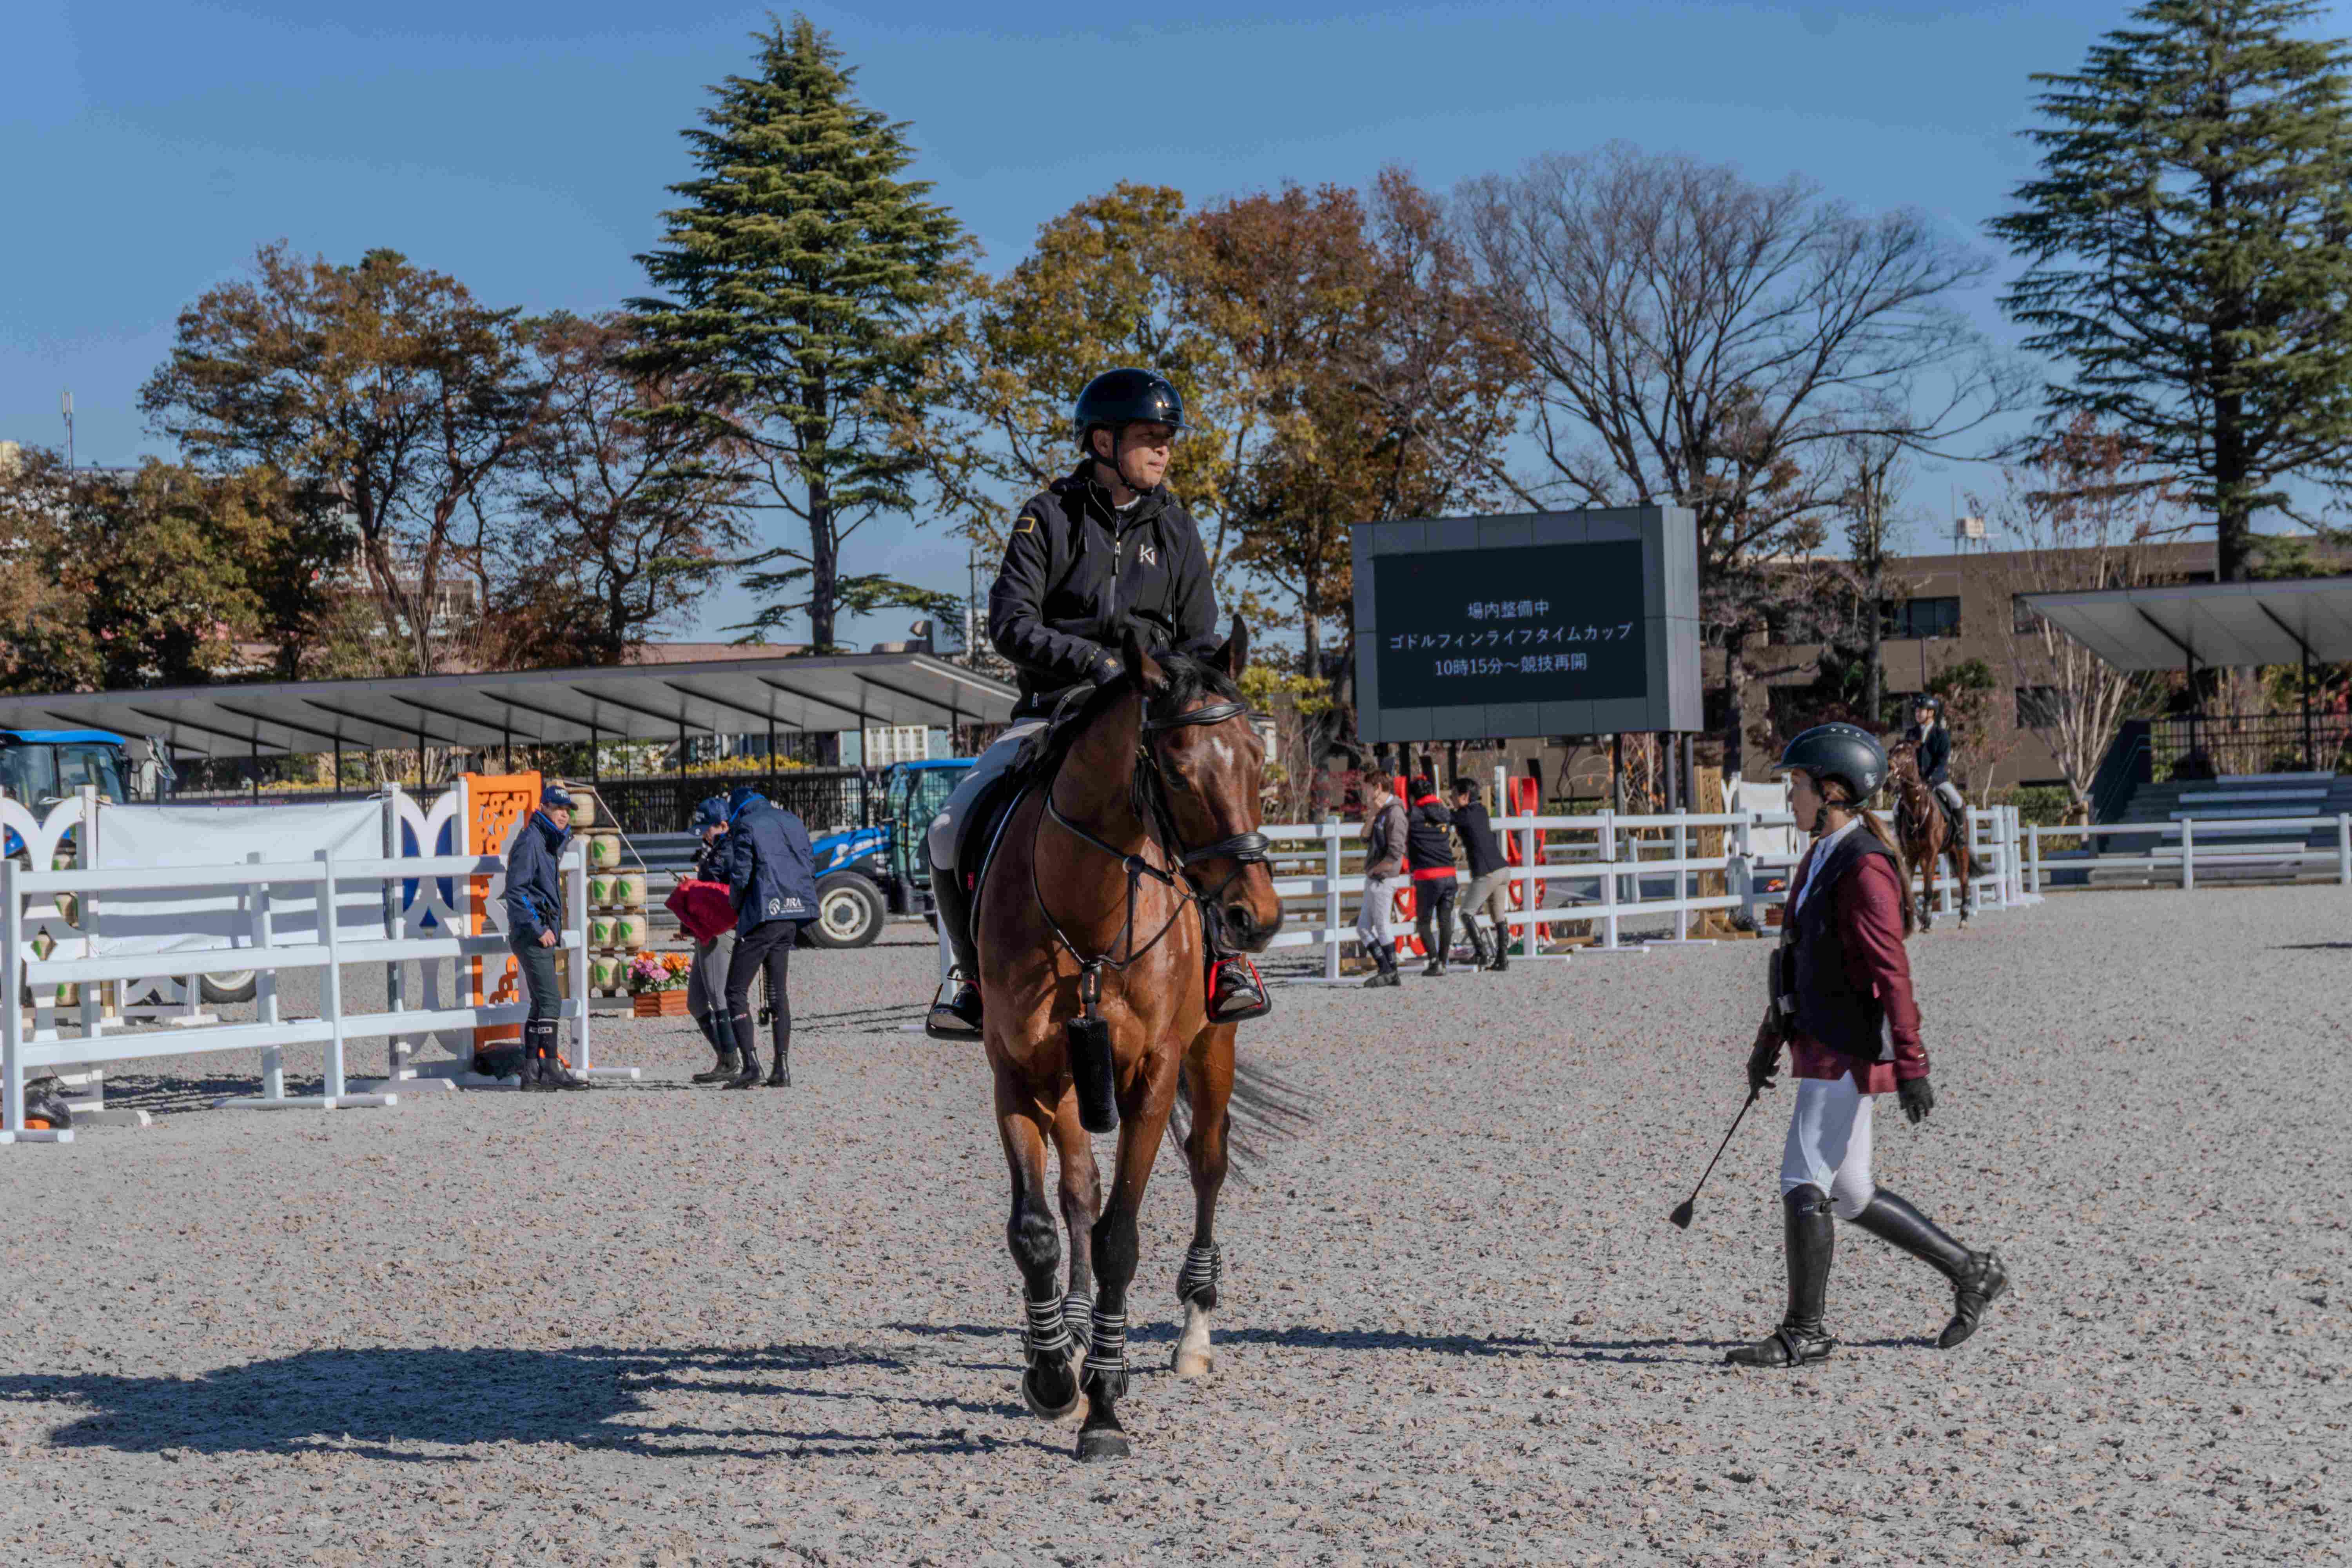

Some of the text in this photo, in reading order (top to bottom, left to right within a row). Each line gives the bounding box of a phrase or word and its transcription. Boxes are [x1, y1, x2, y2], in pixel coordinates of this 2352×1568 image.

[1467, 599, 1550, 619] 場内整備中
[1390, 621, 1633, 650] ゴドルフィンライフタイムカップ
[784, 897, 802, 907] JRA
